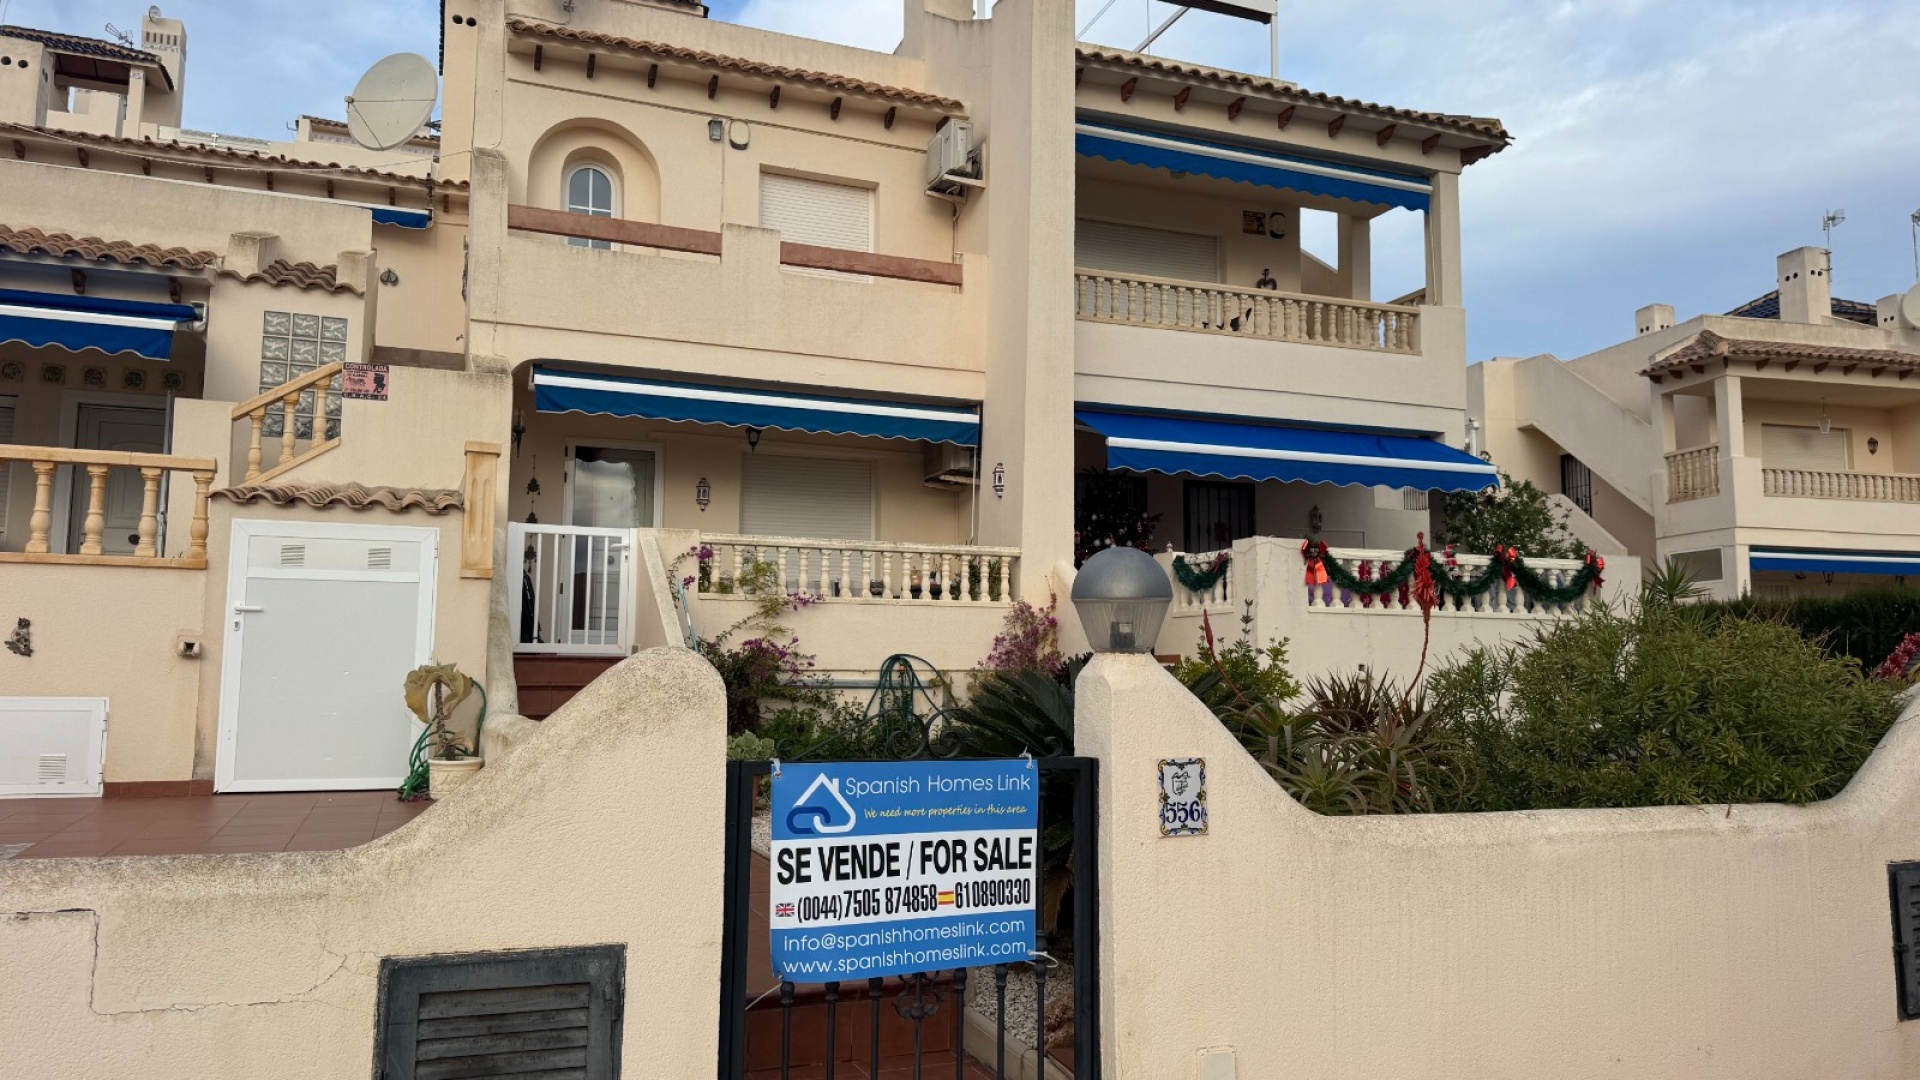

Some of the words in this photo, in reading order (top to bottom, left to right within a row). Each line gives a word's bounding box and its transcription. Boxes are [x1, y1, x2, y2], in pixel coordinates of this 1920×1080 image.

[845, 775, 920, 798] Spanish
[928, 775, 993, 793] Homes
[997, 773, 1031, 791] Link
[863, 806, 878, 819] We
[880, 805, 902, 817] need
[904, 808, 926, 817] more
[928, 804, 973, 819] properties
[974, 803, 985, 814] in
[987, 803, 1005, 815] this
[1006, 806, 1028, 814] area
[1165, 800, 1201, 823] 556
[777, 847, 812, 885] SE
[817, 842, 901, 882] VENDE
[920, 839, 967, 875] FOR
[973, 836, 1033, 871] SALE
[885, 884, 937, 915] 874858
[954, 878, 1031, 909] 610890330
[783, 941, 1026, 974] www.spanishhomeslink.com
